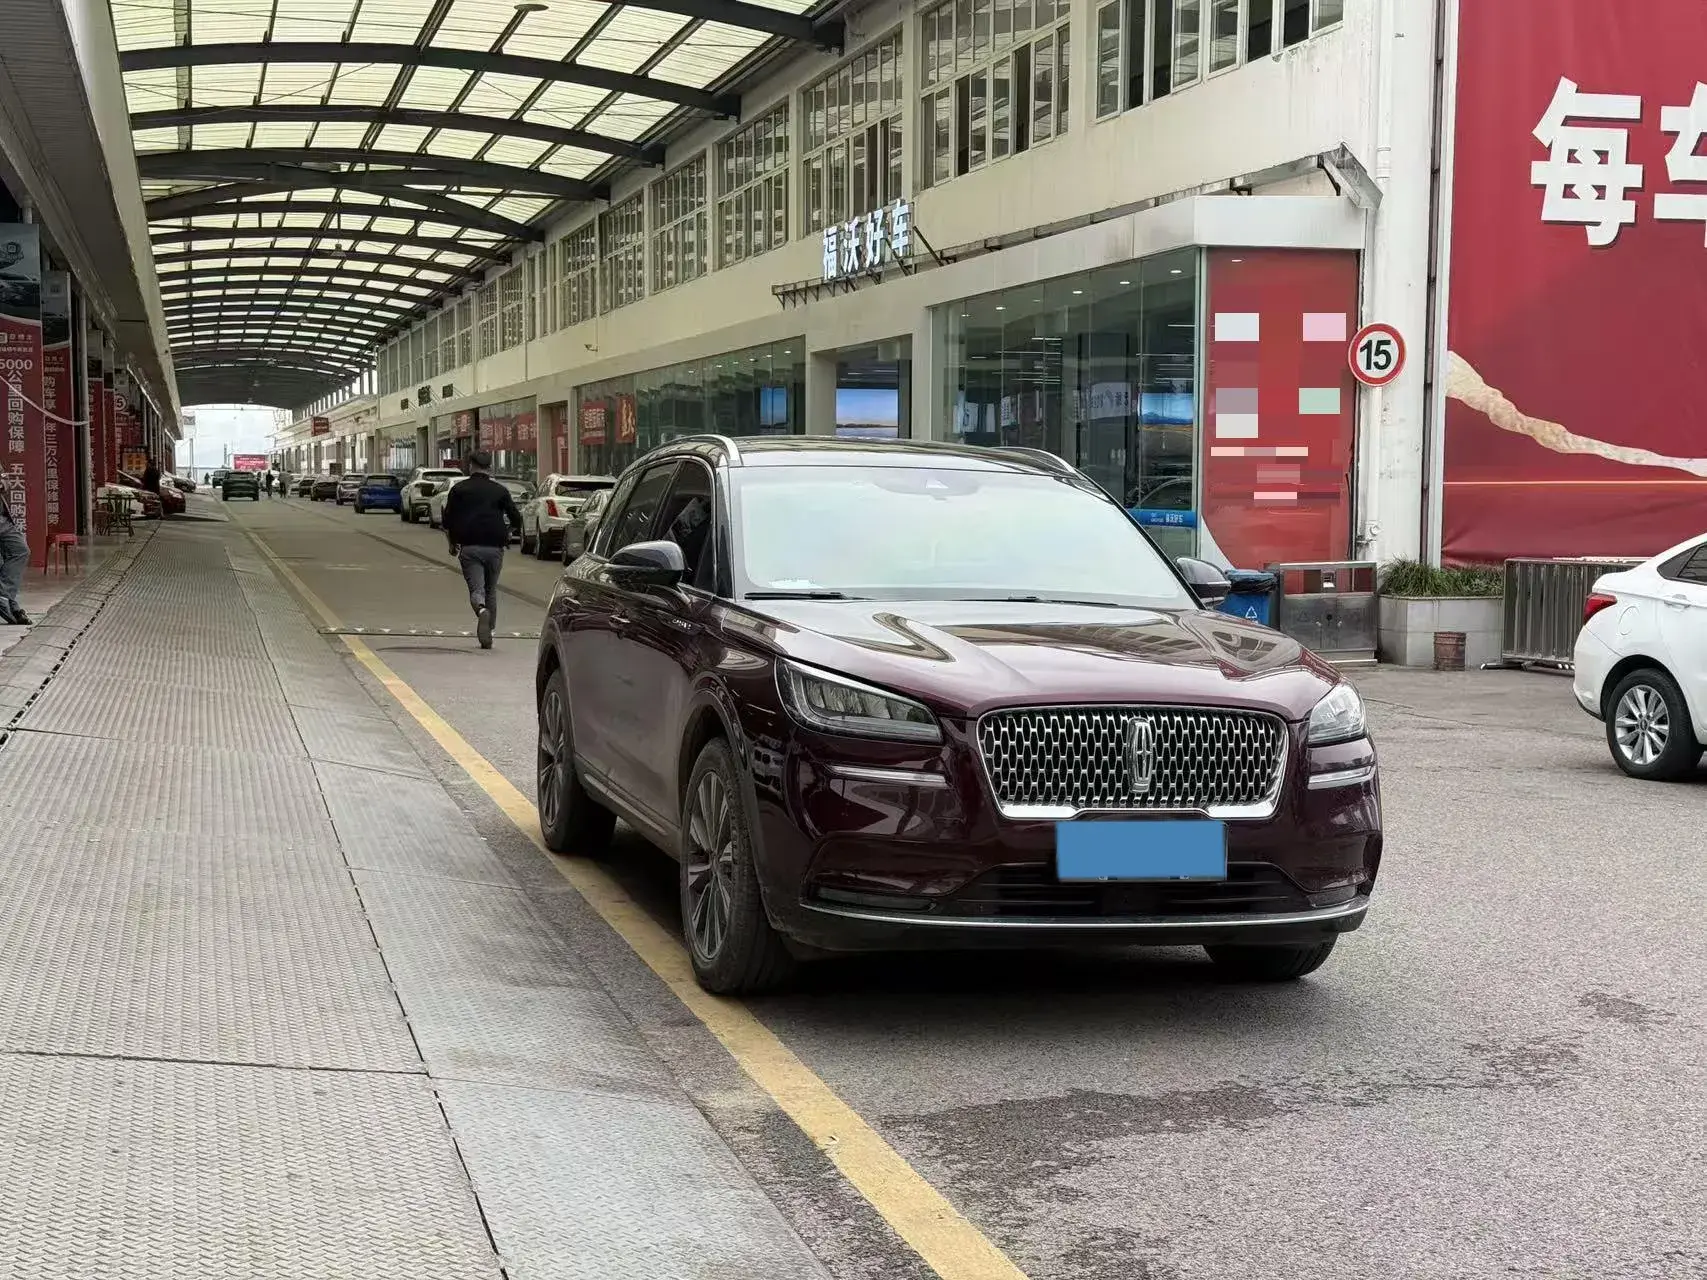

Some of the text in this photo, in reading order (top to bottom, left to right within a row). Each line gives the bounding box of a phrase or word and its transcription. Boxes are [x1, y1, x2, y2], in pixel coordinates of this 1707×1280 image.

[1360, 339, 1392, 371] 15
[10, 463, 27, 537] 五大回购保
